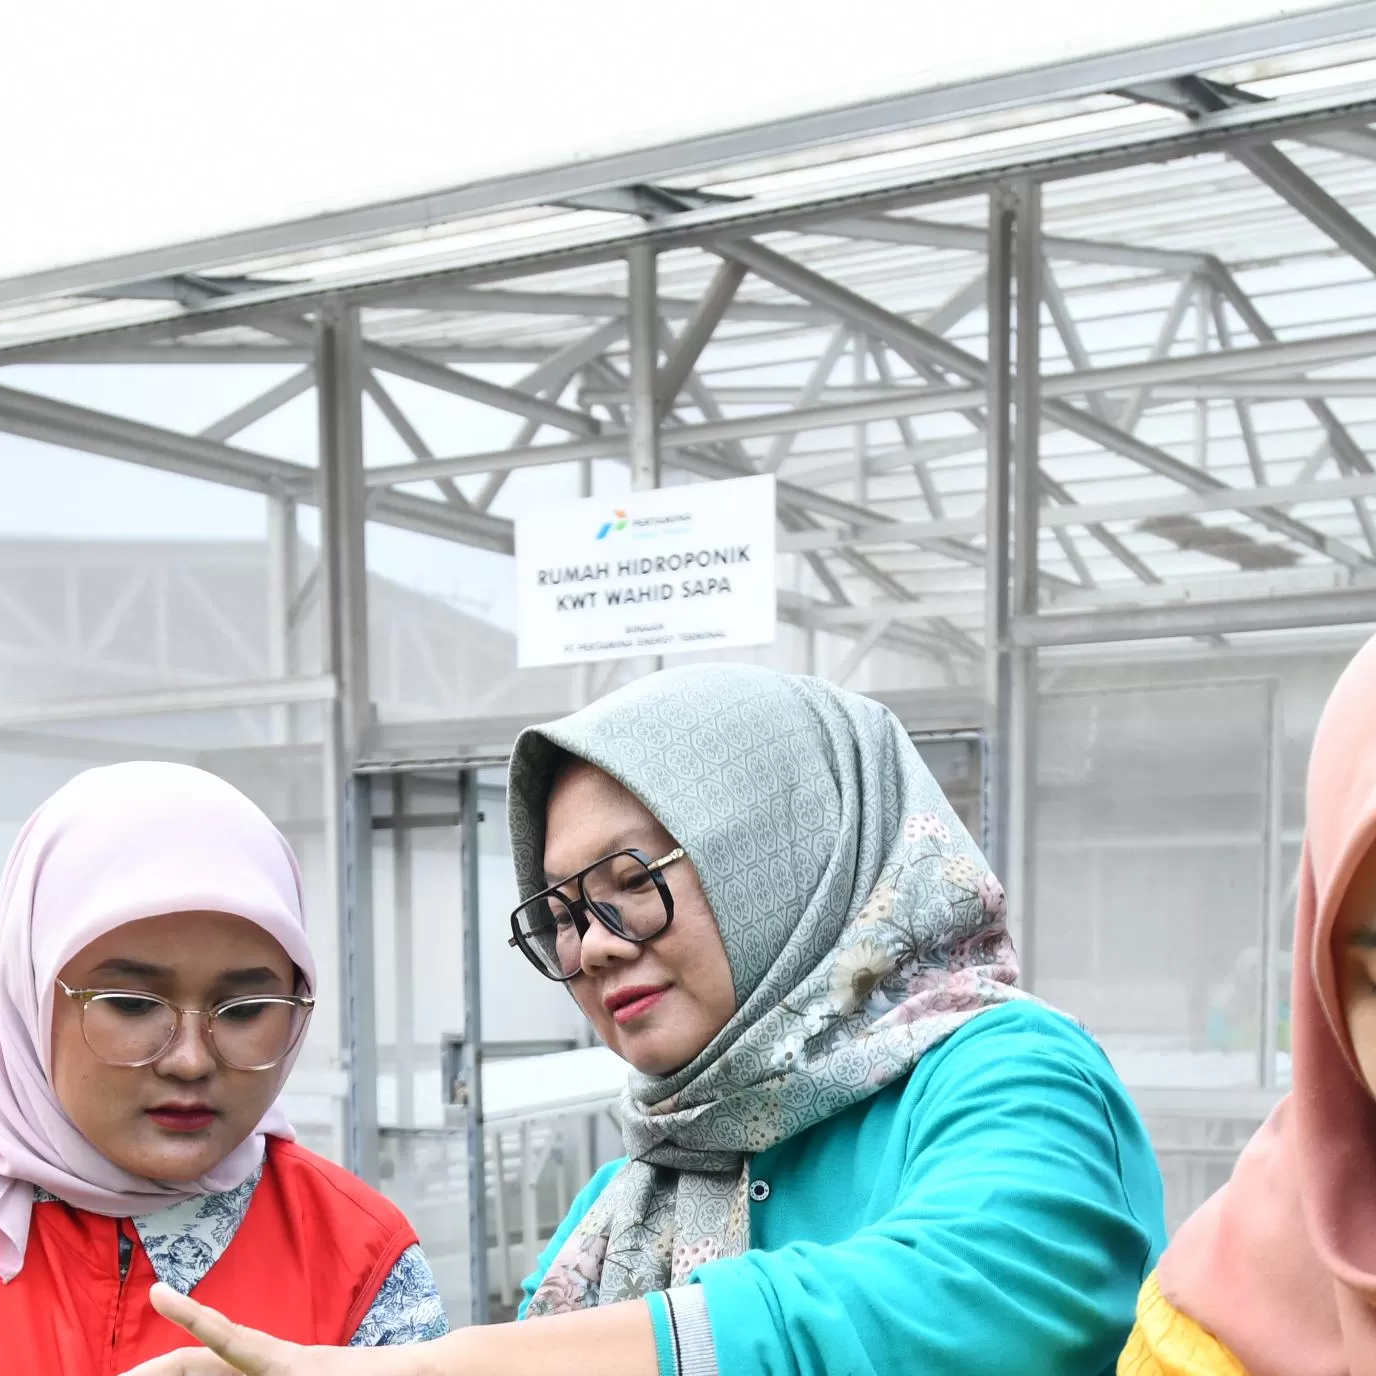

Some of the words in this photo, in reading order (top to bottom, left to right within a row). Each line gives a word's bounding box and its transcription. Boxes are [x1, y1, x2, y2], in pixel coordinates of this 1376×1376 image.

[537, 562, 610, 586] RUMAH
[618, 545, 751, 577] HIDROPONIK
[556, 592, 597, 612] KWT
[605, 583, 674, 606] WAHID
[682, 576, 732, 599] SAPA
